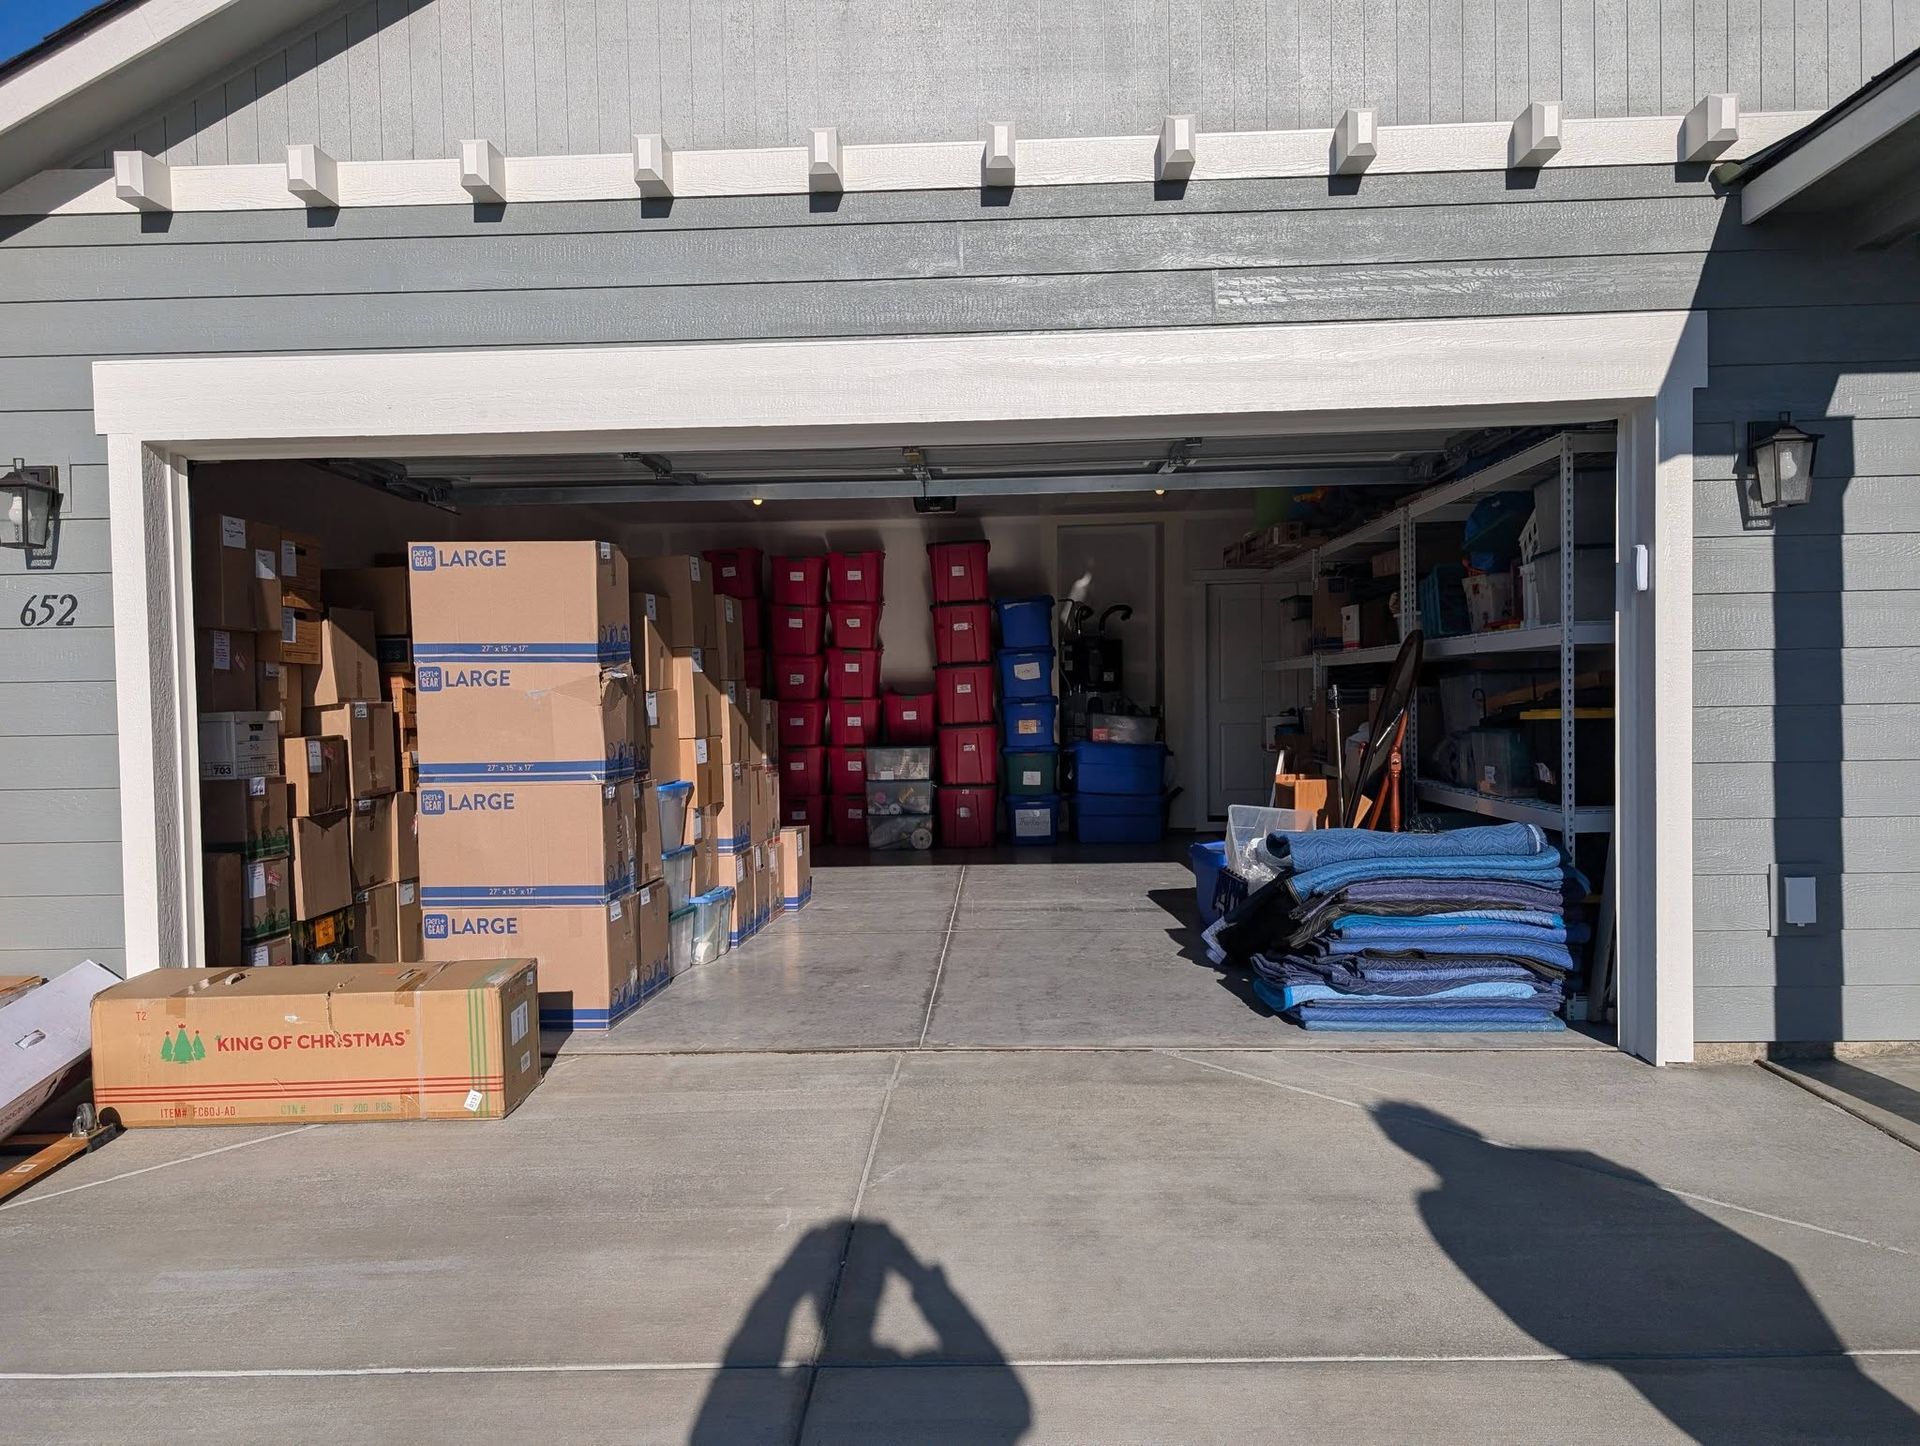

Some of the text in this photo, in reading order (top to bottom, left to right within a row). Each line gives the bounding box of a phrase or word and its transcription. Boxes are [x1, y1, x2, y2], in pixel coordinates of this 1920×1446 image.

[415, 556, 433, 567] GEAR
[439, 549, 507, 567] LARGE
[20, 594, 78, 626] 652
[421, 677, 439, 687] GEAR
[445, 669, 511, 687] LARGE
[213, 767, 232, 775] 703
[424, 800, 442, 811] GEAR
[448, 793, 515, 811] LARGE
[427, 925, 445, 935] GEAR
[451, 917, 517, 935] LARGE
[136, 1011, 147, 1021] T2
[217, 1035, 264, 1052] KING
[267, 1035, 294, 1050] OF
[160, 1107, 188, 1119] ITEM#
